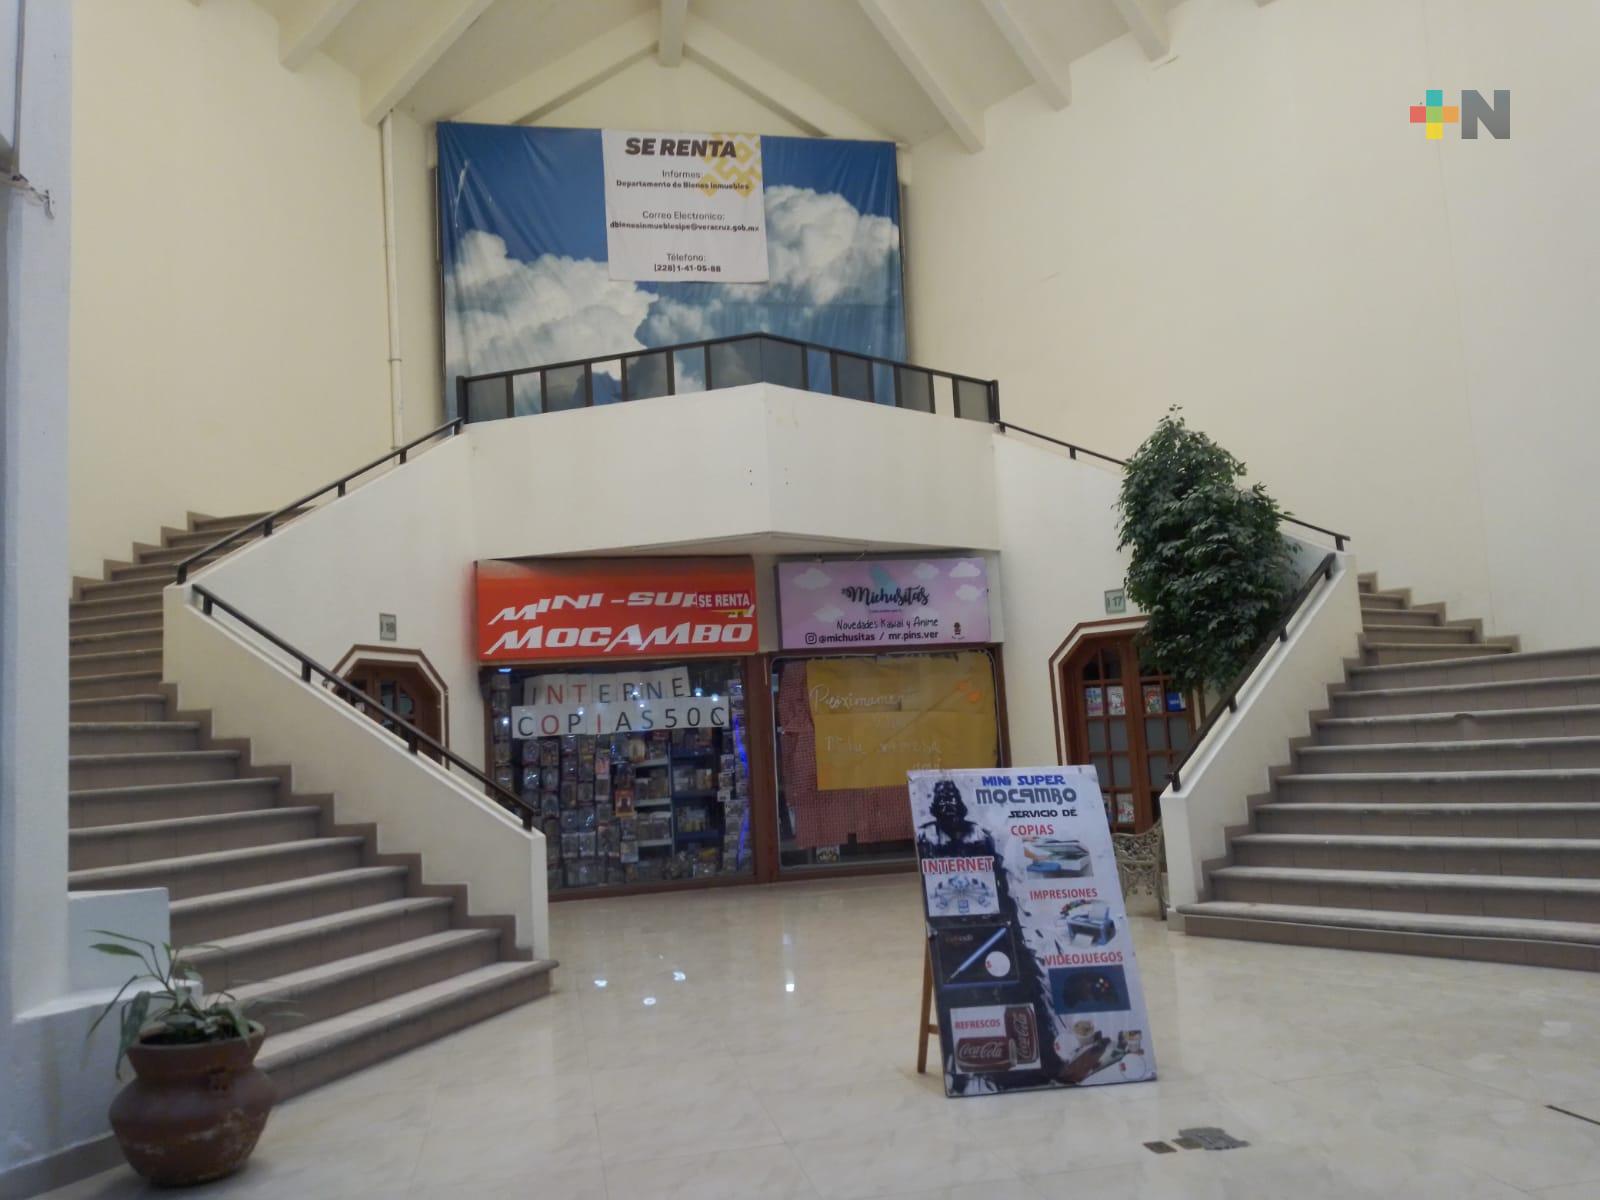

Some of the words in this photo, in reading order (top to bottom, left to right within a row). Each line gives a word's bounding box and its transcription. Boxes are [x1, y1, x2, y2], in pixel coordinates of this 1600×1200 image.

[625, 137, 656, 155] SE
[659, 139, 737, 158] RENTA
[616, 179, 671, 190] Departamento
[672, 181, 682, 189] de
[683, 181, 709, 189] Bienes
[710, 182, 750, 191] Inmuebles
[642, 210, 672, 220] Correo
[698, 594, 712, 608] SE
[715, 593, 750, 607] RENTA
[841, 585, 930, 607] Michusitas
[837, 619, 878, 631] Novedades
[913, 616, 938, 628] Anime
[484, 622, 753, 655] MOCAMBO
[818, 632, 875, 644] @michusitas
[888, 630, 939, 641] mr.pins.ver
[532, 676, 686, 705] INTERNE
[981, 776, 1012, 786] MINI
[1017, 775, 1066, 786] SUPER
[1008, 809, 1058, 818] SERVICIO
[1010, 824, 1054, 836] COPIAS
[922, 857, 993, 873] INTERNET
[1029, 888, 1098, 900] IMPRESIONES
[1045, 951, 1124, 966] VIDEOJUEGOS
[954, 1019, 1001, 1030] REFRESCOS
